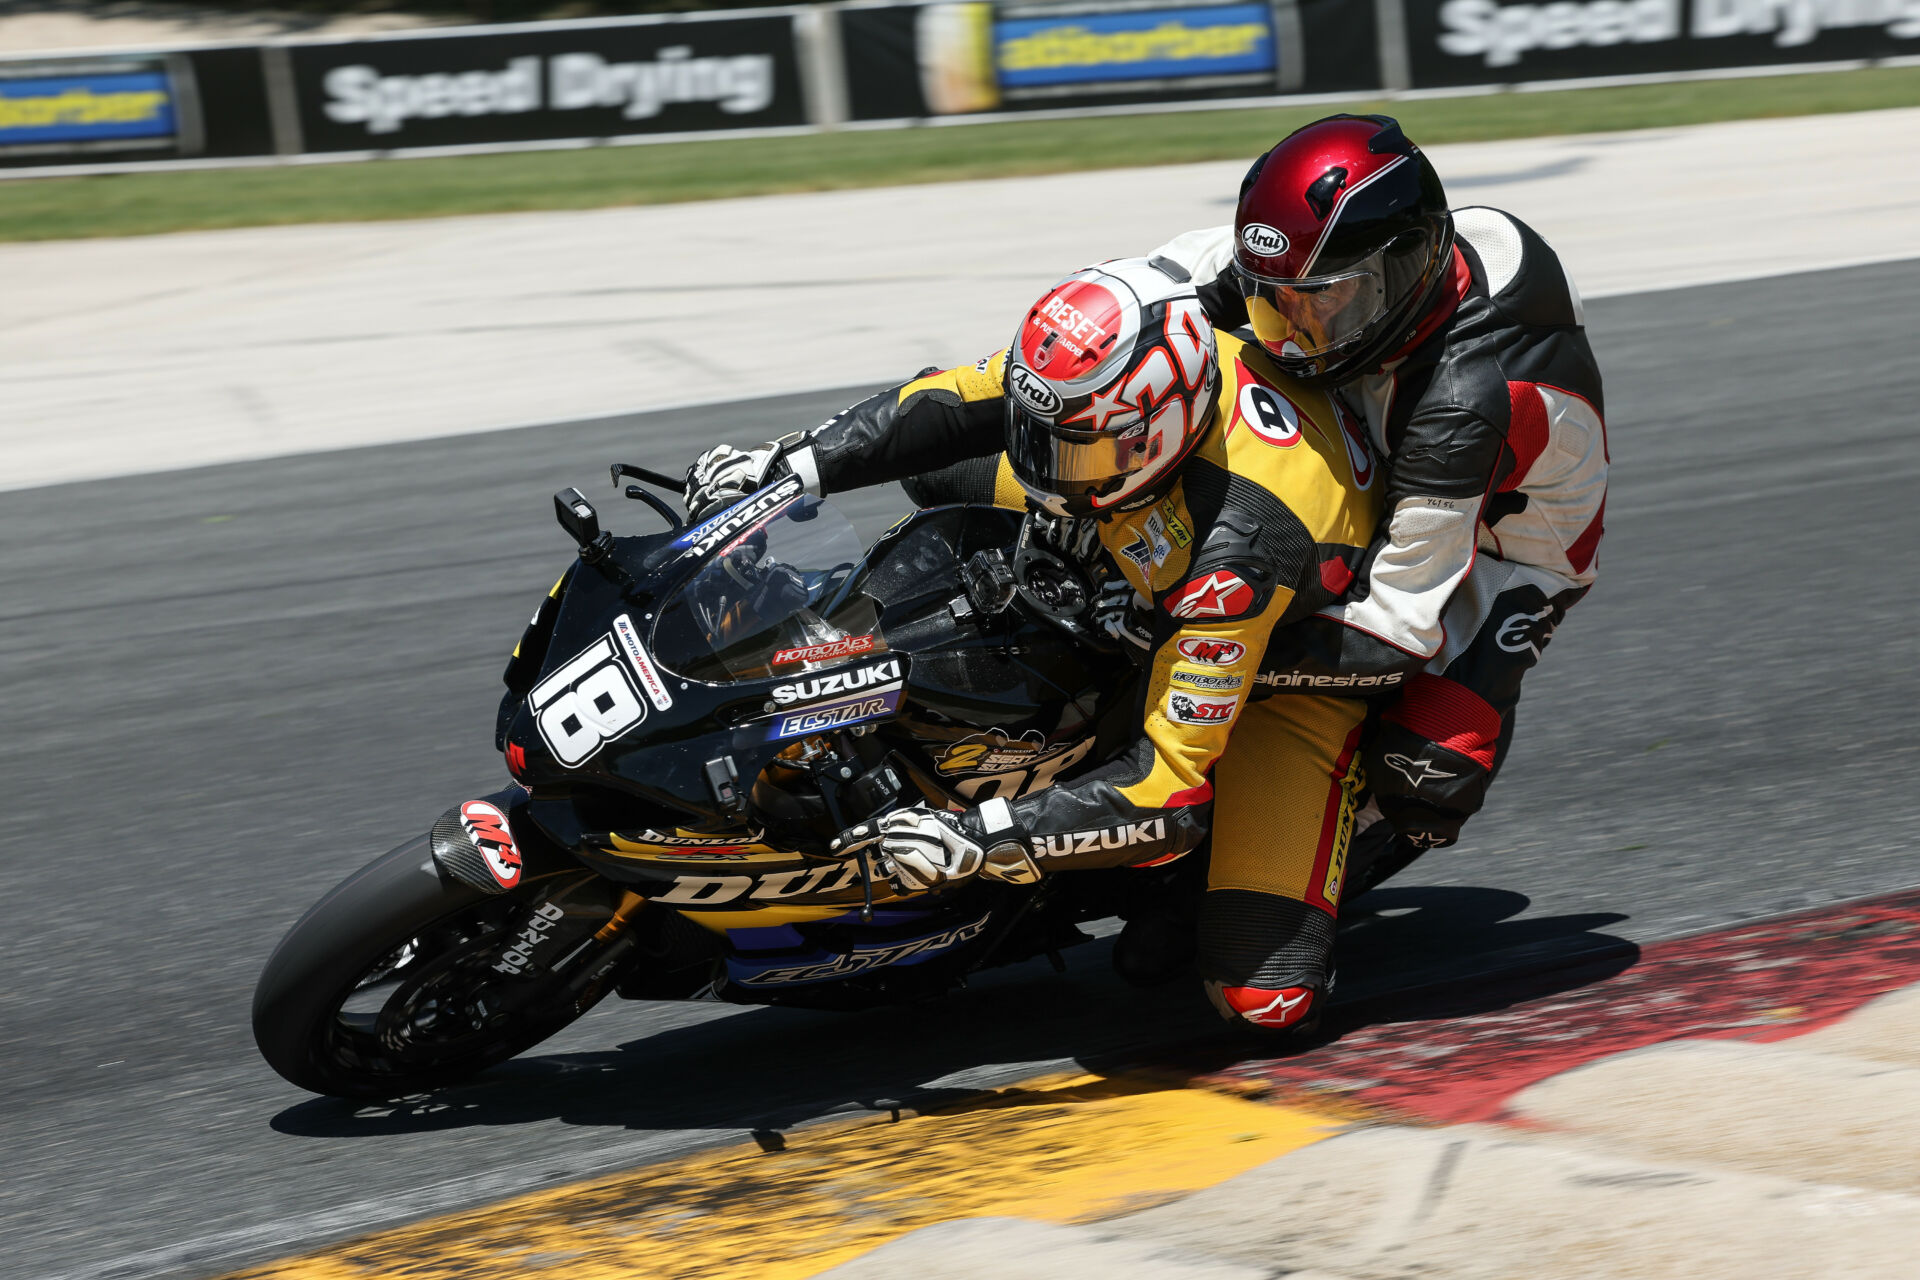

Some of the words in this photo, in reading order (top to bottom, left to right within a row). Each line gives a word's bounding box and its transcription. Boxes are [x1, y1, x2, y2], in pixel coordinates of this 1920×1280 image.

[1436, 0, 1682, 67] Speed
[323, 55, 543, 134] Speed
[546, 45, 775, 119] Drying
[1244, 227, 1283, 249] Arai
[1032, 317, 1042, 326] &
[1041, 295, 1106, 346] RESET
[1011, 372, 1055, 408] Arai
[692, 480, 800, 557] SUZUKI
[623, 632, 661, 695] MOTOAMERICA
[1190, 641, 1237, 664] M4
[772, 659, 901, 704] SUZUKI
[1254, 670, 1404, 687] alpinestars
[528, 632, 648, 768] 18
[779, 698, 892, 737] ECSTAR
[1192, 701, 1237, 720] STG
[939, 743, 988, 771] 2
[984, 754, 1038, 765] SEAT
[1031, 817, 1166, 859] SUZUKI
[491, 902, 565, 976] DUNLOP
